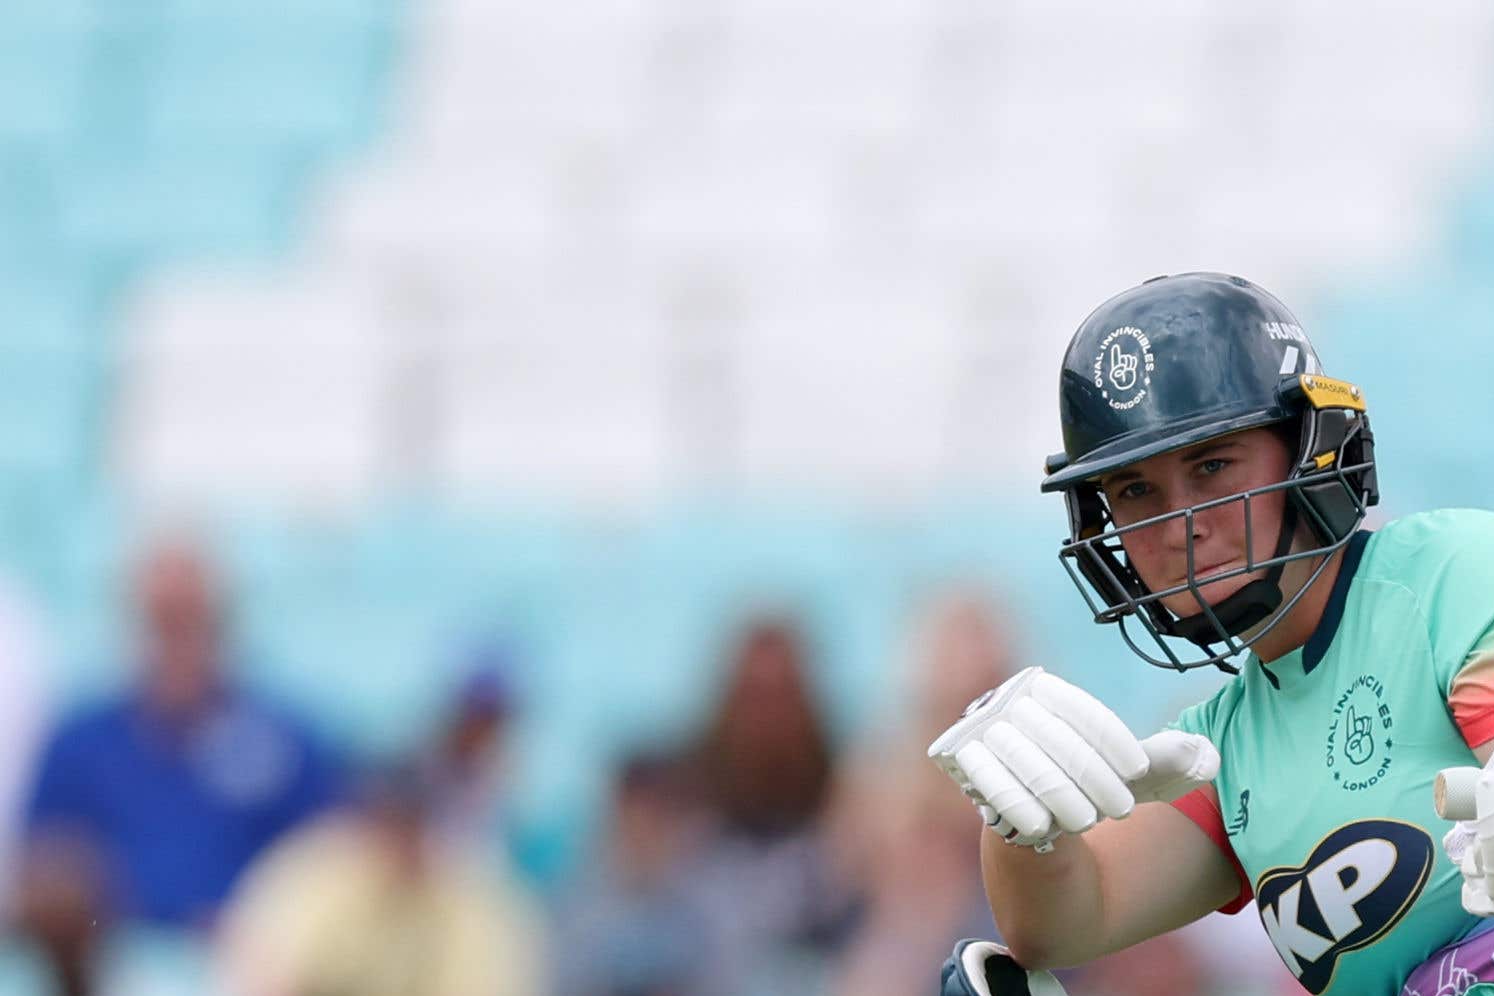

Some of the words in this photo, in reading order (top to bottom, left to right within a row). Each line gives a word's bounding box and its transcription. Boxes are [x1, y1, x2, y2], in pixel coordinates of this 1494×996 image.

[1094, 352, 1104, 388] OVAL
[1100, 326, 1154, 372] INVINCIBLES
[1108, 389, 1147, 410] LONDON
[1326, 719, 1339, 768] OVAL
[1333, 675, 1393, 730] INVINCIES
[1342, 757, 1391, 791] LONDON
[1261, 838, 1398, 980] KP
